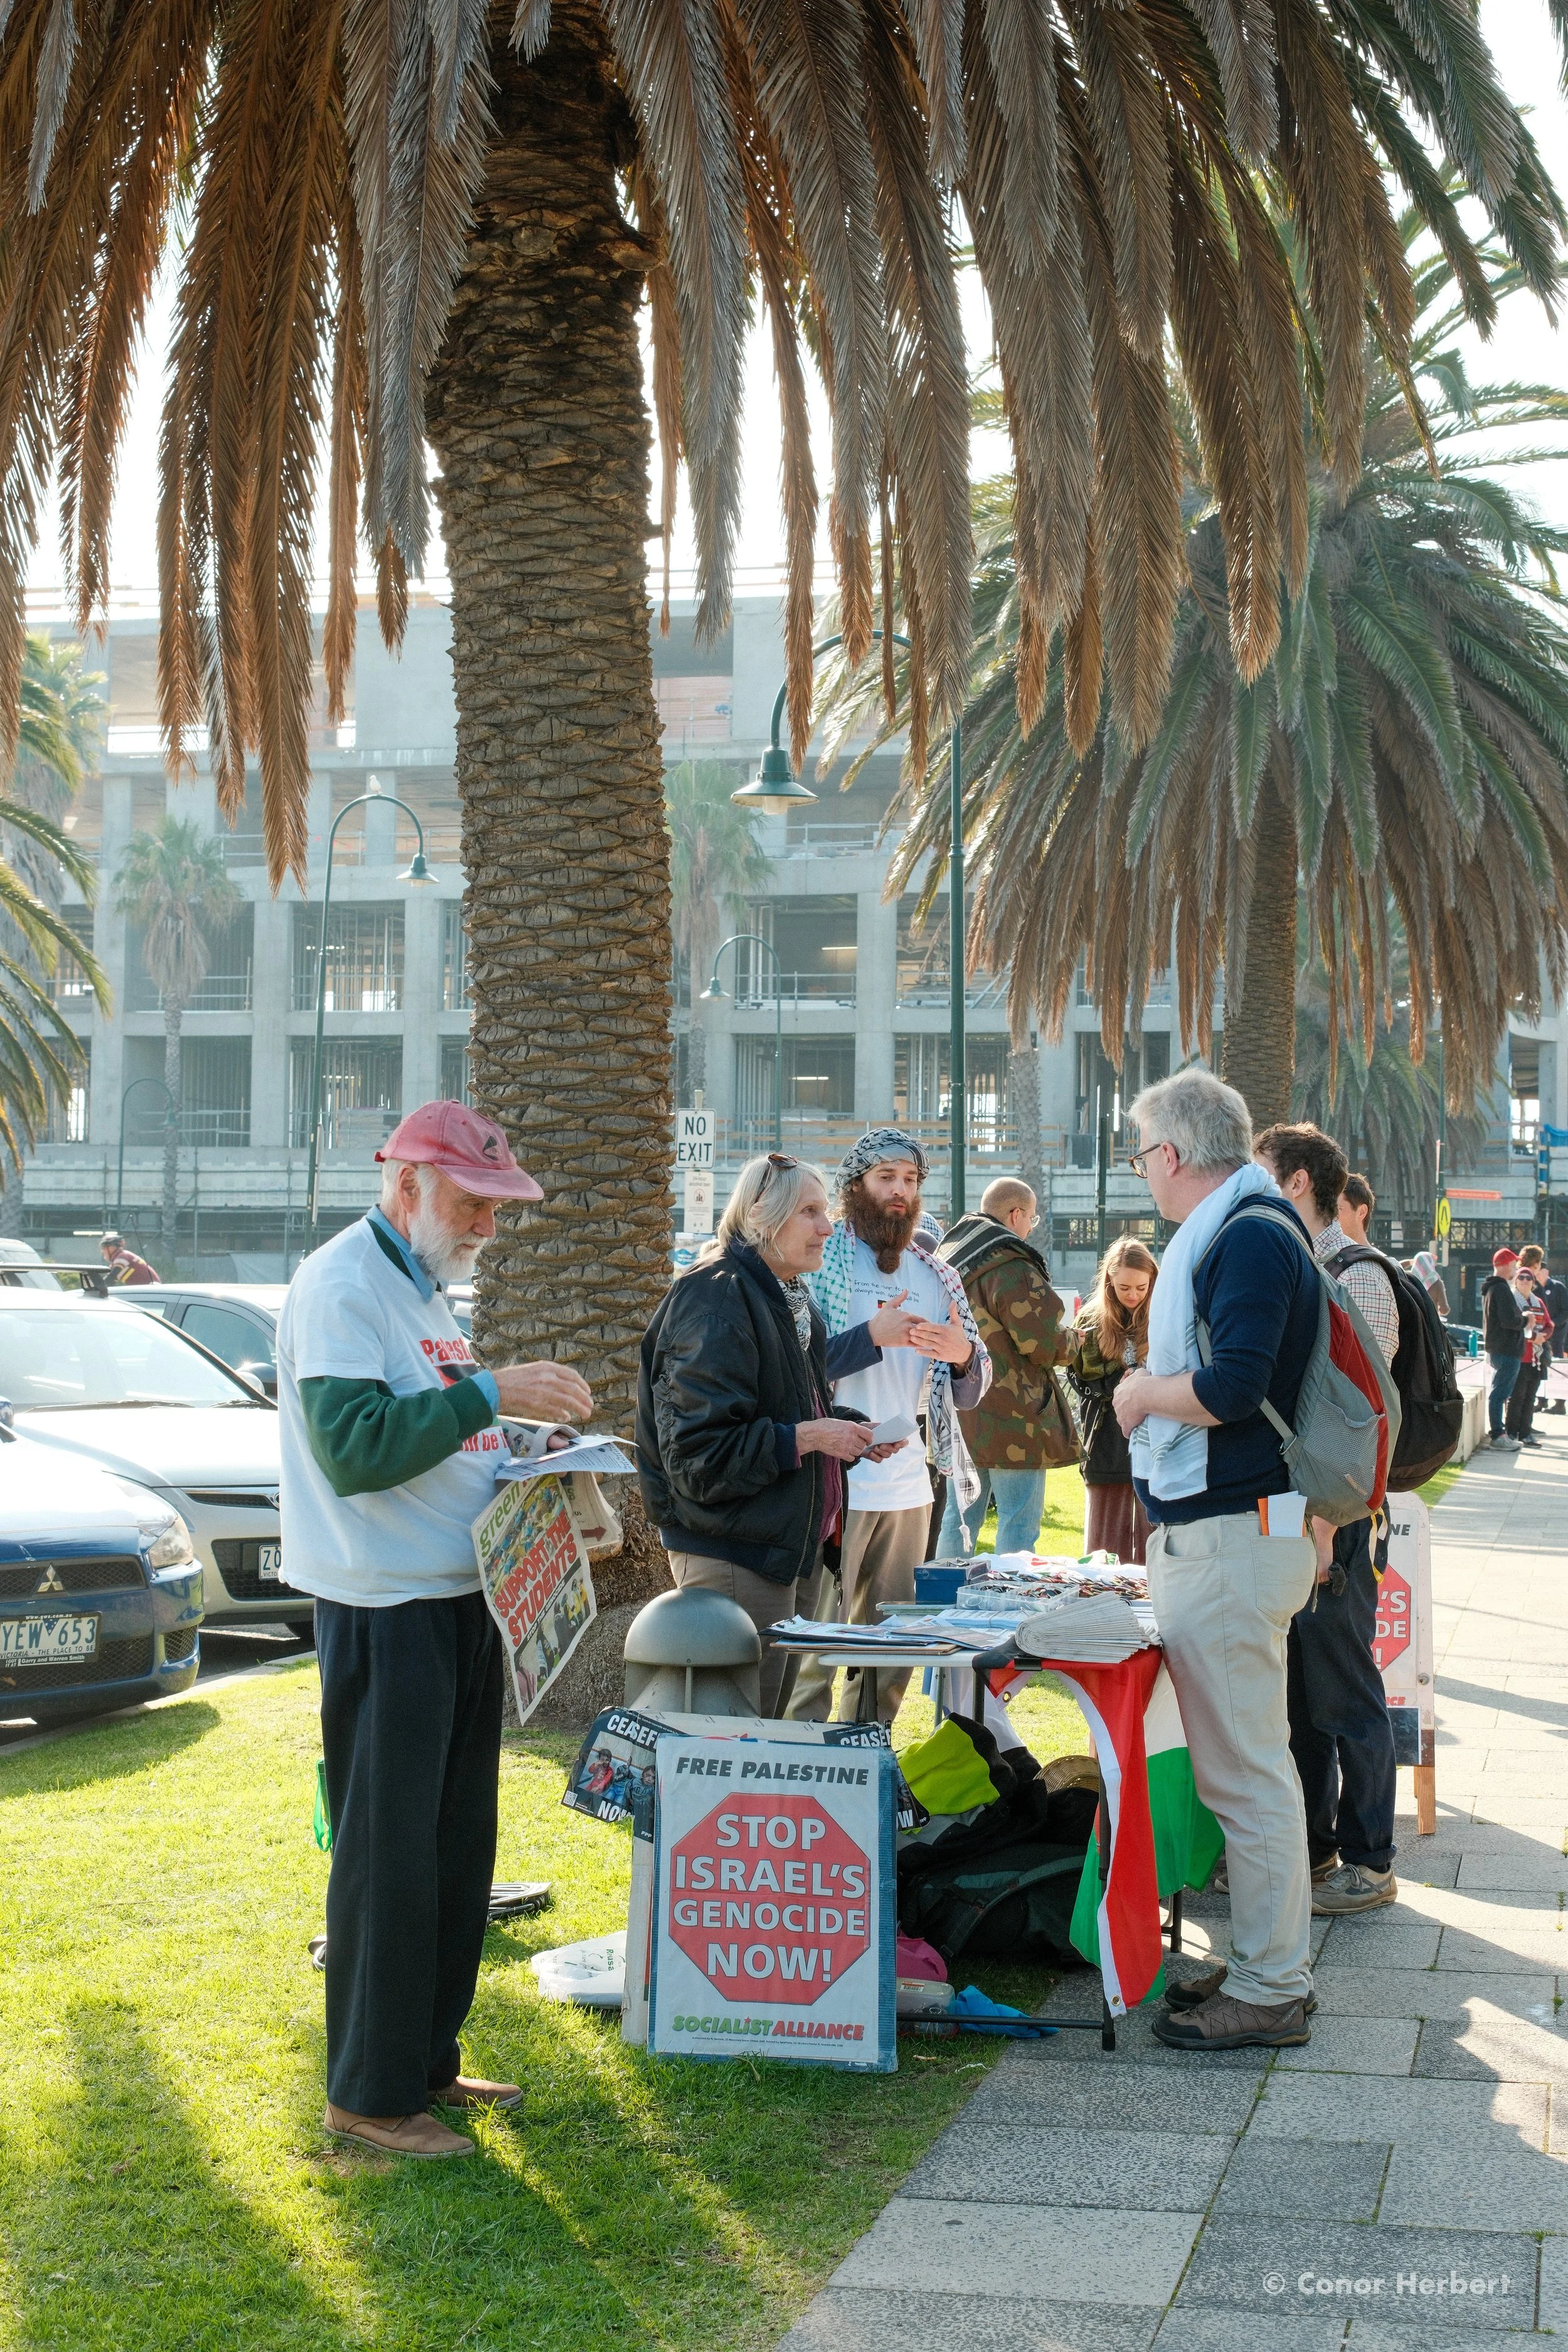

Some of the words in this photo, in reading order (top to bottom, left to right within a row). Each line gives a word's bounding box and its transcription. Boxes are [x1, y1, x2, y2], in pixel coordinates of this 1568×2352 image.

[685, 1116, 706, 1135] NO
[678, 1143, 712, 1162] EXIT
[482, 1431, 499, 1451] be
[479, 1481, 521, 1558] green
[494, 1537, 550, 1618] SUPPORT
[546, 1508, 571, 1550] THE
[507, 1533, 578, 1647] STUDENTS
[3, 1622, 43, 1651] YEW
[58, 1618, 96, 1646] 653
[0, 1650, 29, 1659] VICTORIA
[676, 1757, 733, 1777] FREE
[741, 1761, 869, 1786] PALESTINE
[716, 1813, 826, 1850] STOP
[675, 1855, 866, 1899] ISRAEL'S
[673, 1899, 866, 1936] GENOCIDE
[707, 1942, 832, 1983] NOW!
[771, 2020, 864, 2040] ALLIANCE
